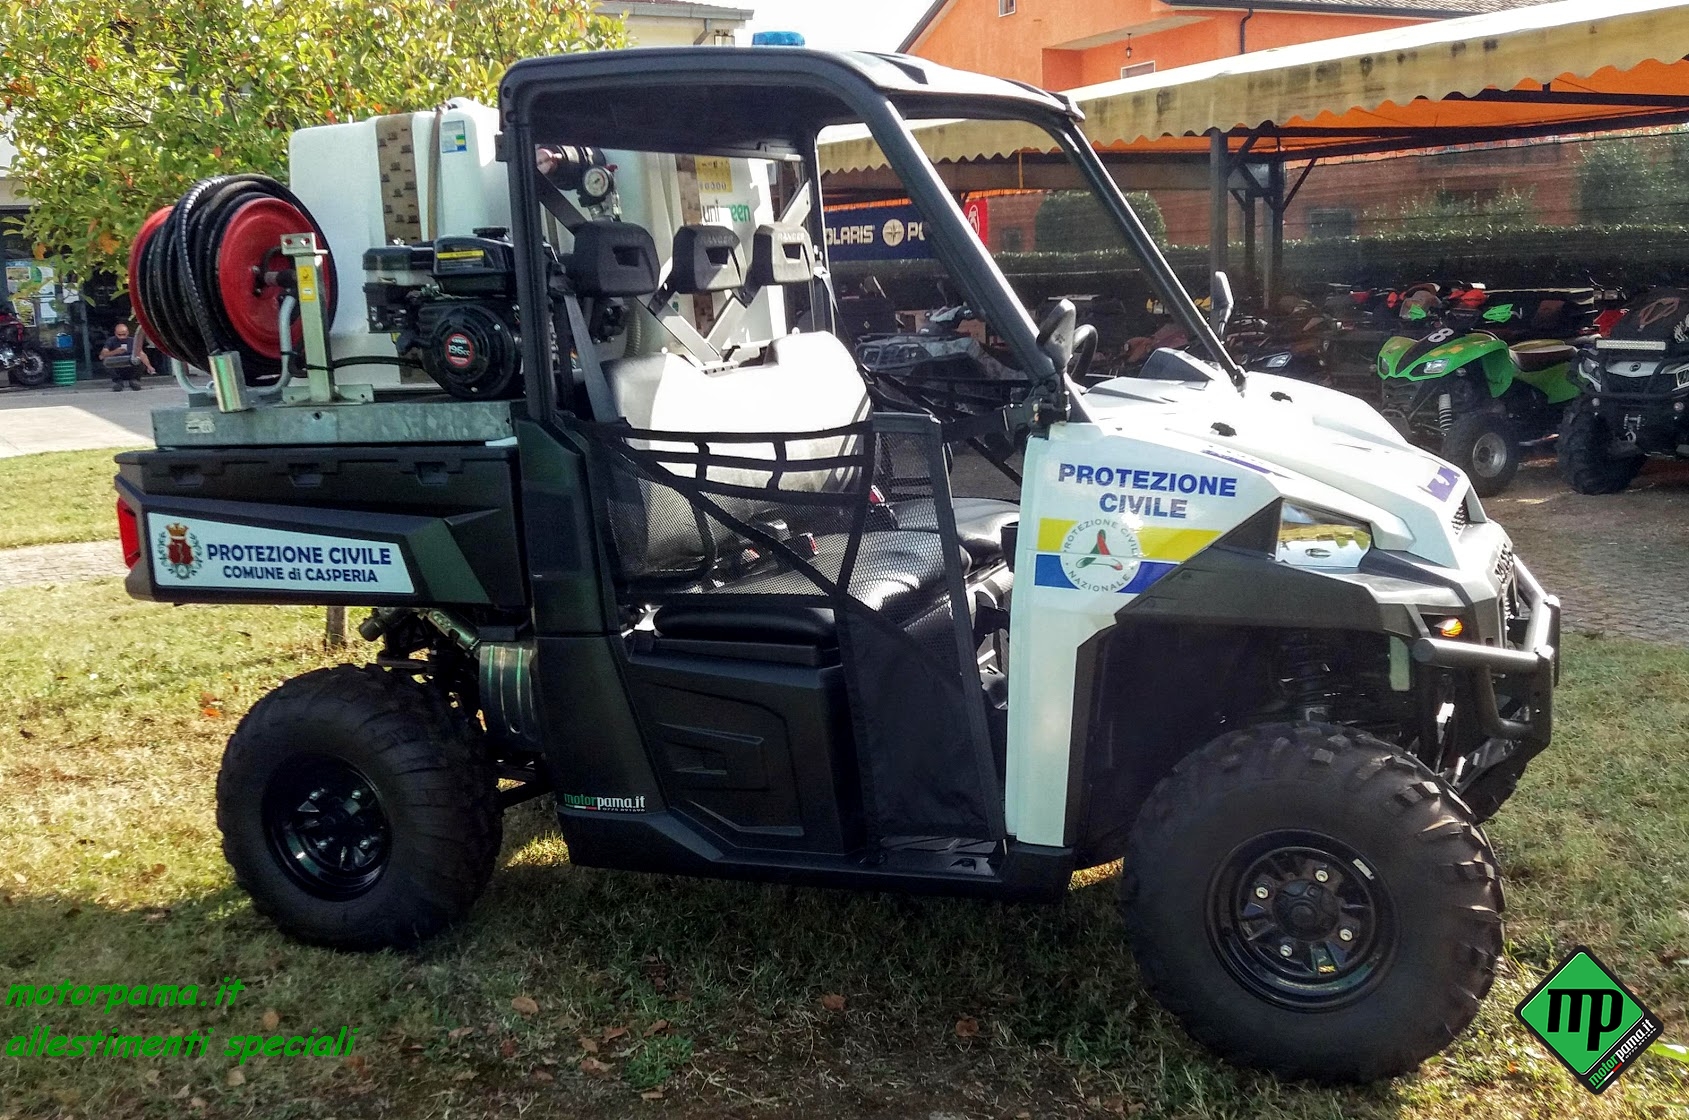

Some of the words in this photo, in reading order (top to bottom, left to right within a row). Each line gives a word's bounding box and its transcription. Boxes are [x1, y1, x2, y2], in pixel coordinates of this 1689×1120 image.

[703, 199, 751, 222] unieen
[826, 224, 874, 245] OLARIS
[1427, 327, 1455, 343] 8
[1058, 463, 1237, 497] PROTEZIONE
[1099, 493, 1188, 519] CIVILE
[1063, 518, 1119, 553] ROTEZIONE
[206, 543, 324, 564] PROTEZIONE
[328, 547, 392, 565] CIVILE
[223, 565, 284, 580] COMUNE
[288, 567, 301, 581] di
[305, 569, 379, 583] CASPERIA
[1068, 570, 1131, 592] NAZIONALE
[564, 793, 646, 811] motorpama.it
